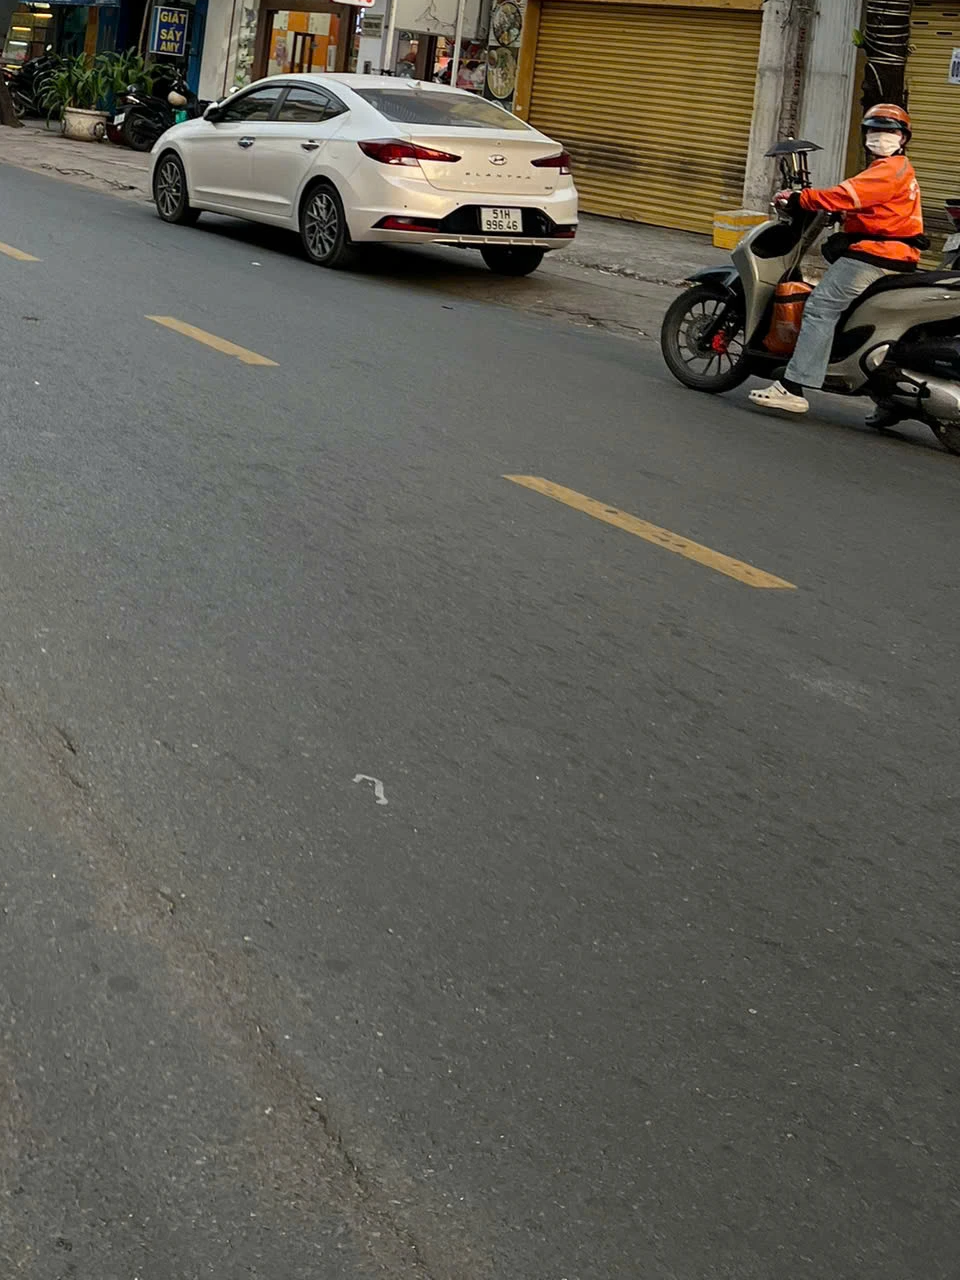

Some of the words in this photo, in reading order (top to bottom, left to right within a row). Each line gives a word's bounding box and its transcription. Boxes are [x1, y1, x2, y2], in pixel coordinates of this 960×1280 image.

[160, 26, 183, 41] SẤY
[160, 41, 180, 52] AMY
[492, 209, 511, 219] 51H
[486, 220, 518, 231] 996.46
